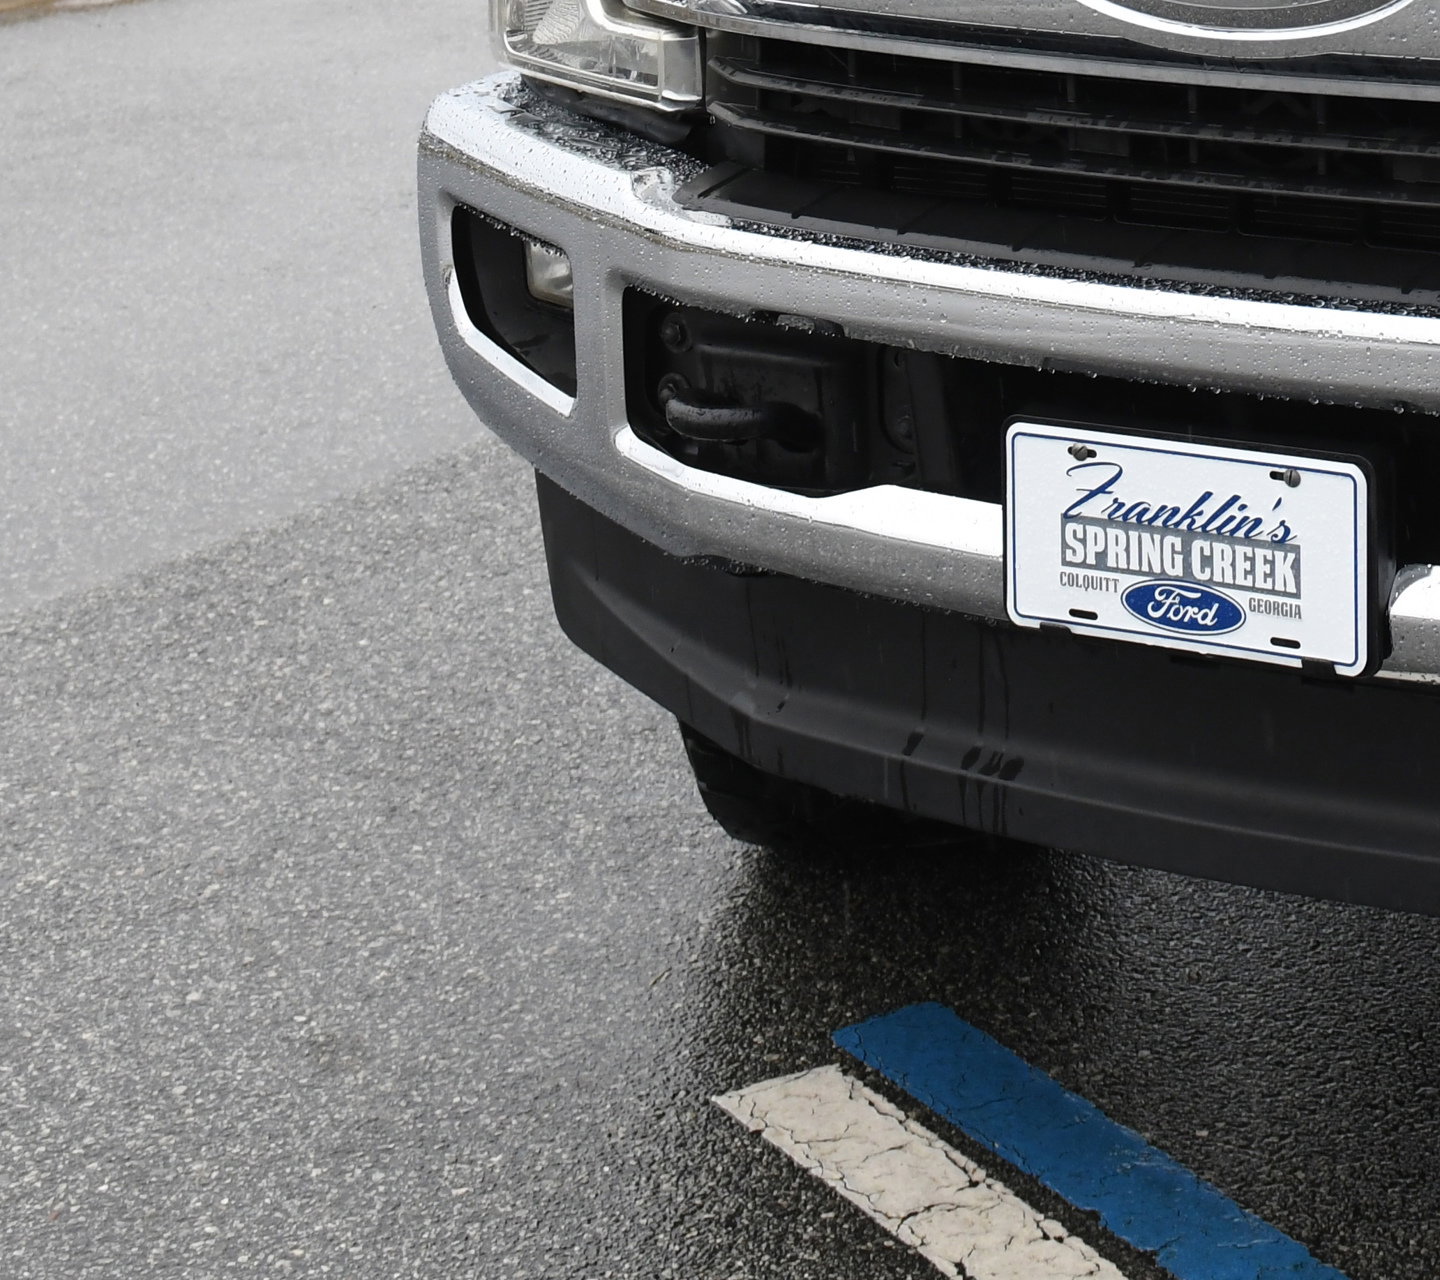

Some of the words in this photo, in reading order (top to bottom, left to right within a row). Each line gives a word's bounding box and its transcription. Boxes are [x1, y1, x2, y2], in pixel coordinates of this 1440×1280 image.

[1063, 461, 1298, 544] Franklin's
[1064, 522, 1184, 578] SPRING
[1191, 539, 1298, 594] CREEK
[1060, 571, 1120, 593] COLQUITT
[1147, 586, 1219, 626] Ford
[1248, 597, 1303, 620] GEORGIA
